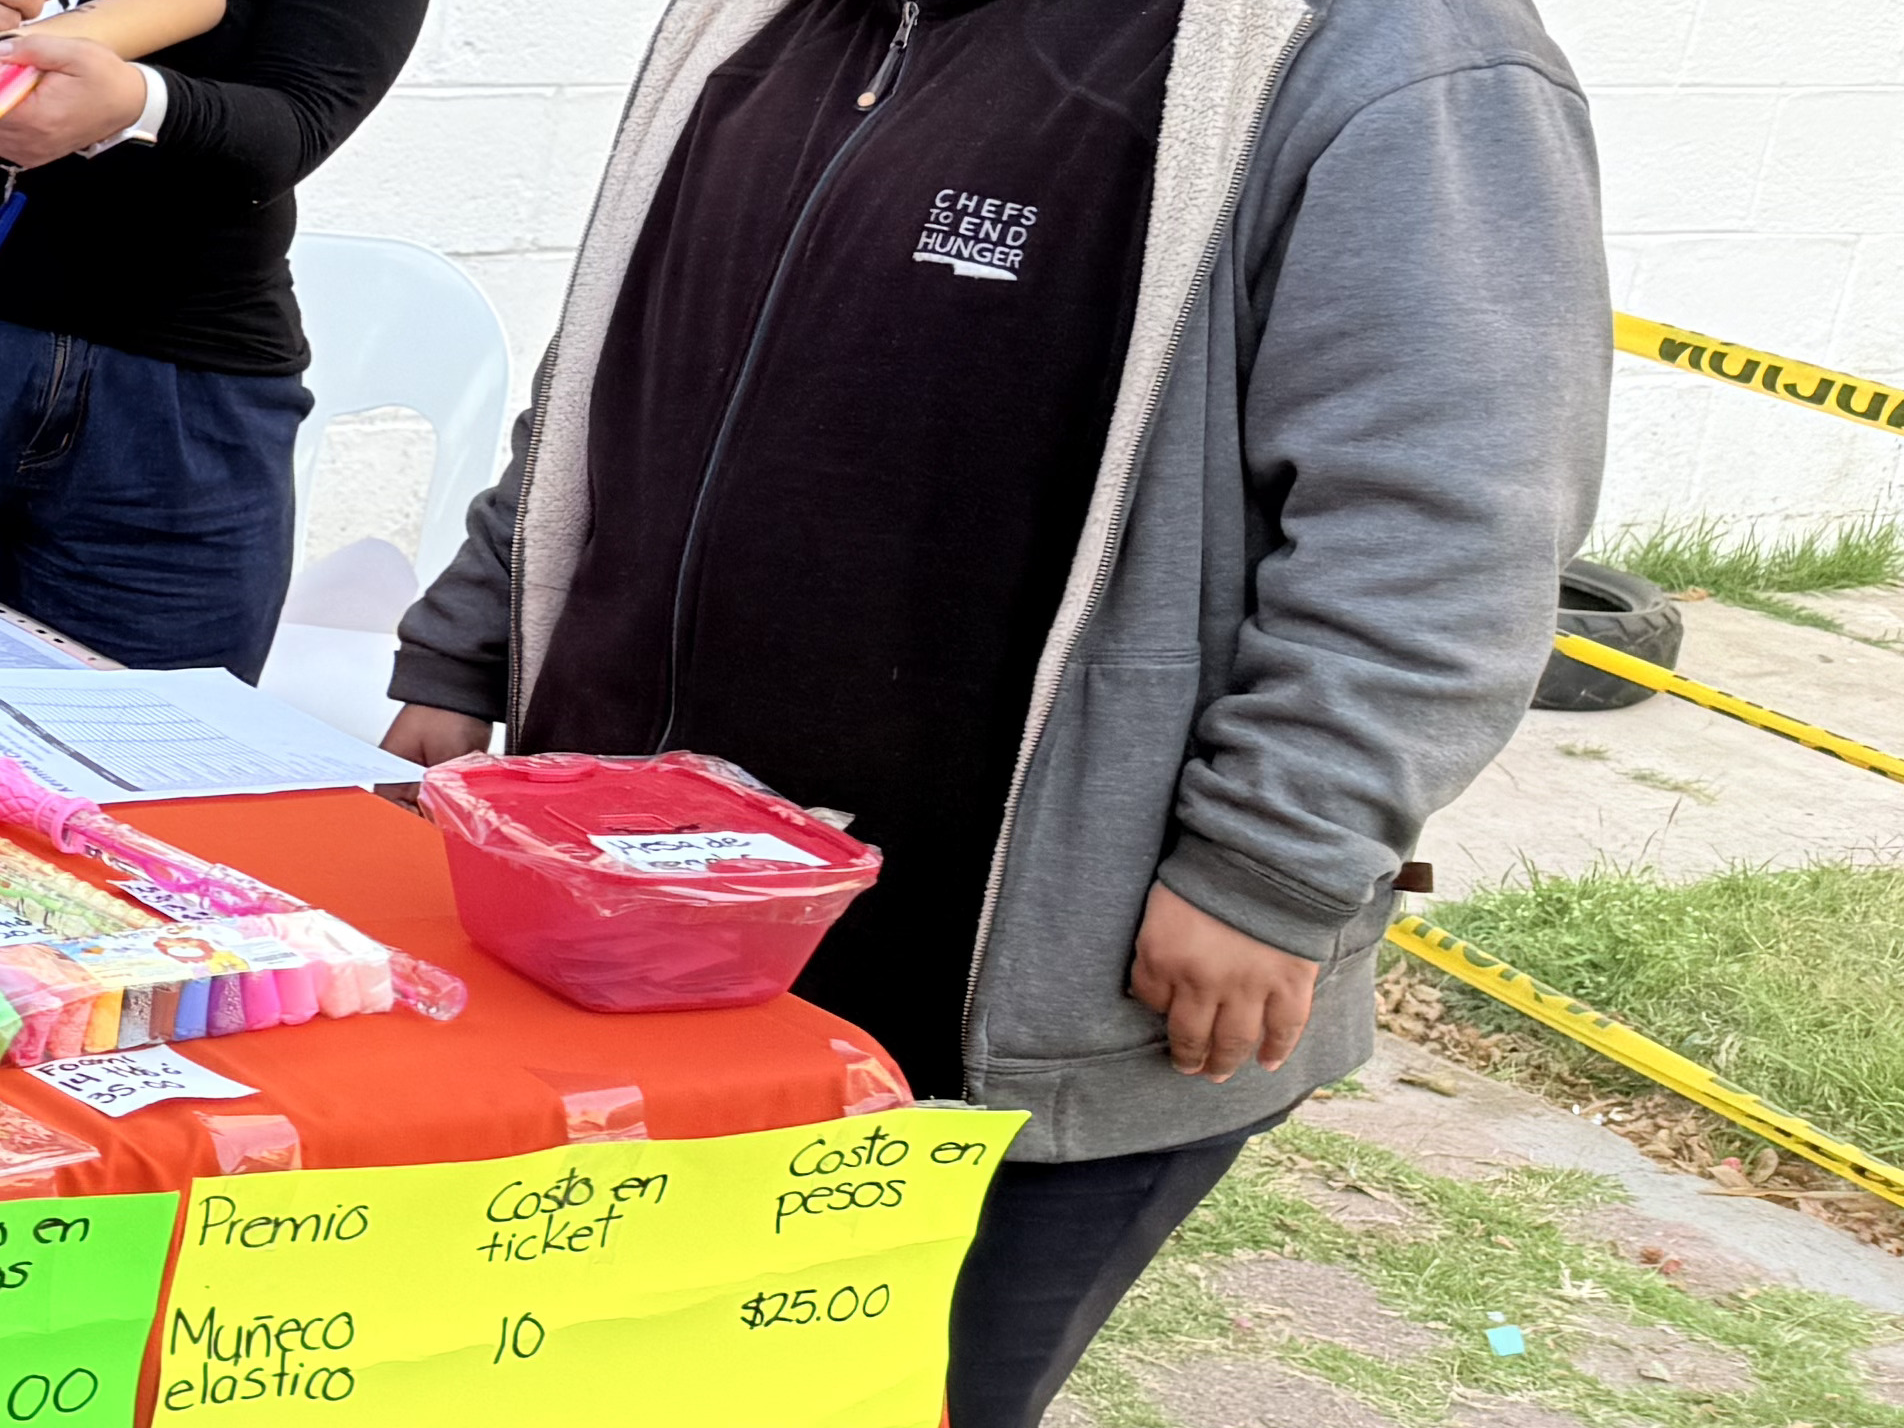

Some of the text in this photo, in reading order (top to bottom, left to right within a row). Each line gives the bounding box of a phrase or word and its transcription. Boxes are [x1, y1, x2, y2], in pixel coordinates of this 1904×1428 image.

[935, 189, 1038, 225] CHEFS
[930, 209, 1028, 246] TO END
[918, 232, 1024, 269] HUNGER
[33, 1218, 89, 1244] en
[741, 1284, 889, 1329] $25.00
[165, 1355, 354, 1412] elastico
